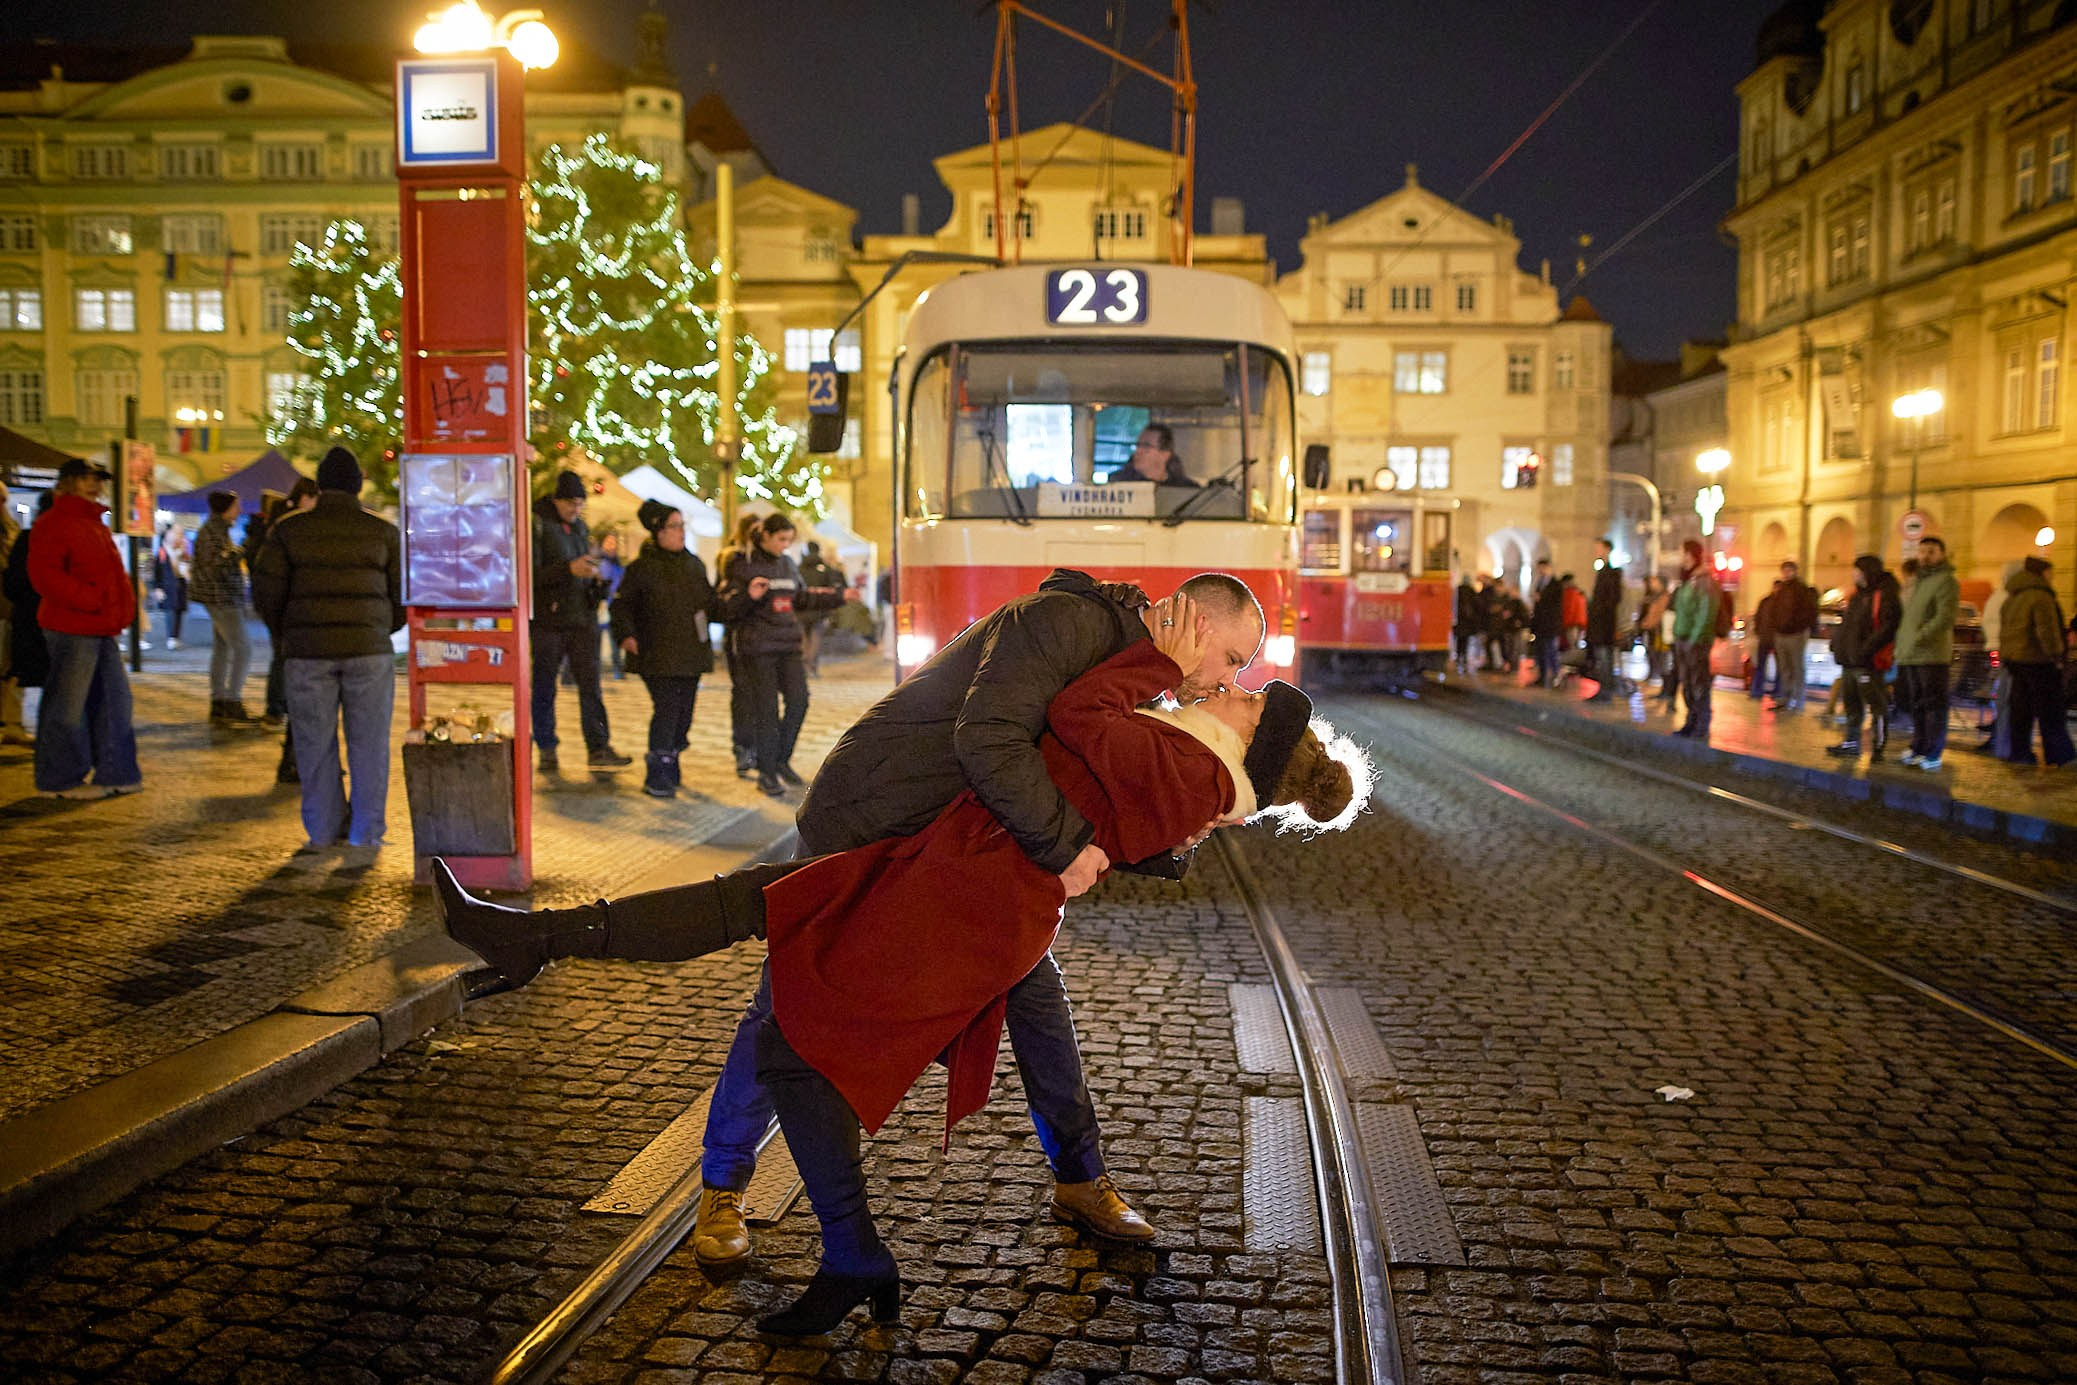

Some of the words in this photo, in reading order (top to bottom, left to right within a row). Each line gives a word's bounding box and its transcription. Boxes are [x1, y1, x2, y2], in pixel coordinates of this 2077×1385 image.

[1056, 269, 1139, 323] 23
[809, 371, 838, 406] 23
[1060, 490, 1133, 503] VINOHRADY
